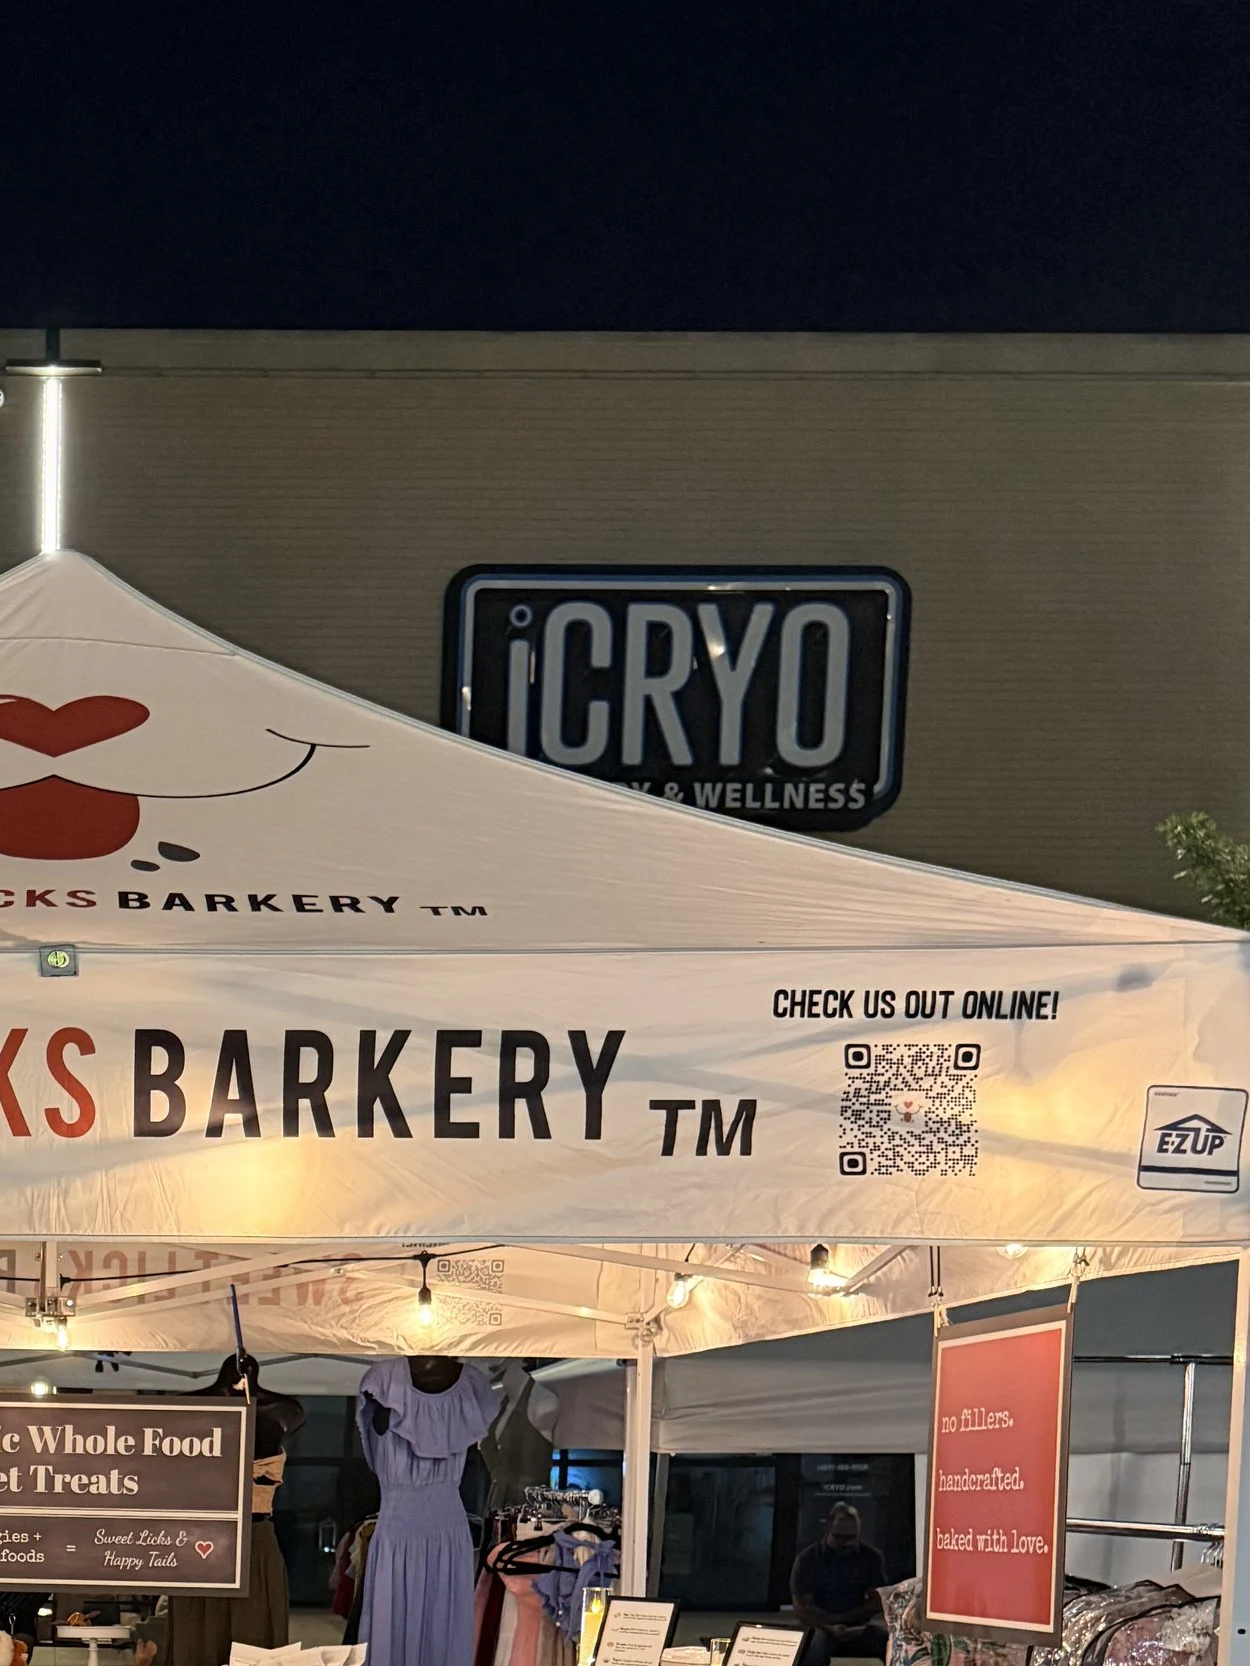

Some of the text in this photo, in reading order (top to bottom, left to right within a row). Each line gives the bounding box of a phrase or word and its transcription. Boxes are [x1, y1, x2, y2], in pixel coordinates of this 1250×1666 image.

[507, 600, 850, 767] iCRYO
[664, 782, 684, 803] &
[693, 781, 866, 810] WELLNESS
[117, 890, 401, 915] BARKERY
[419, 905, 488, 917] TM
[773, 989, 1060, 1020] CHECK US OUT ONLINE!
[133, 1028, 626, 1140] BARKERY
[649, 1098, 757, 1157] TM
[941, 1407, 1014, 1433] no fillers.
[27, 1424, 135, 1456] Whole
[141, 1427, 223, 1458] Food
[29, 1464, 140, 1496] Treats
[938, 1467, 1024, 1492] handcrafted.
[94, 1530, 134, 1546] Sweet
[135, 1530, 172, 1547] Licks
[936, 1528, 1049, 1554] baked with love.
[103, 1551, 178, 1571] Happy Tails
